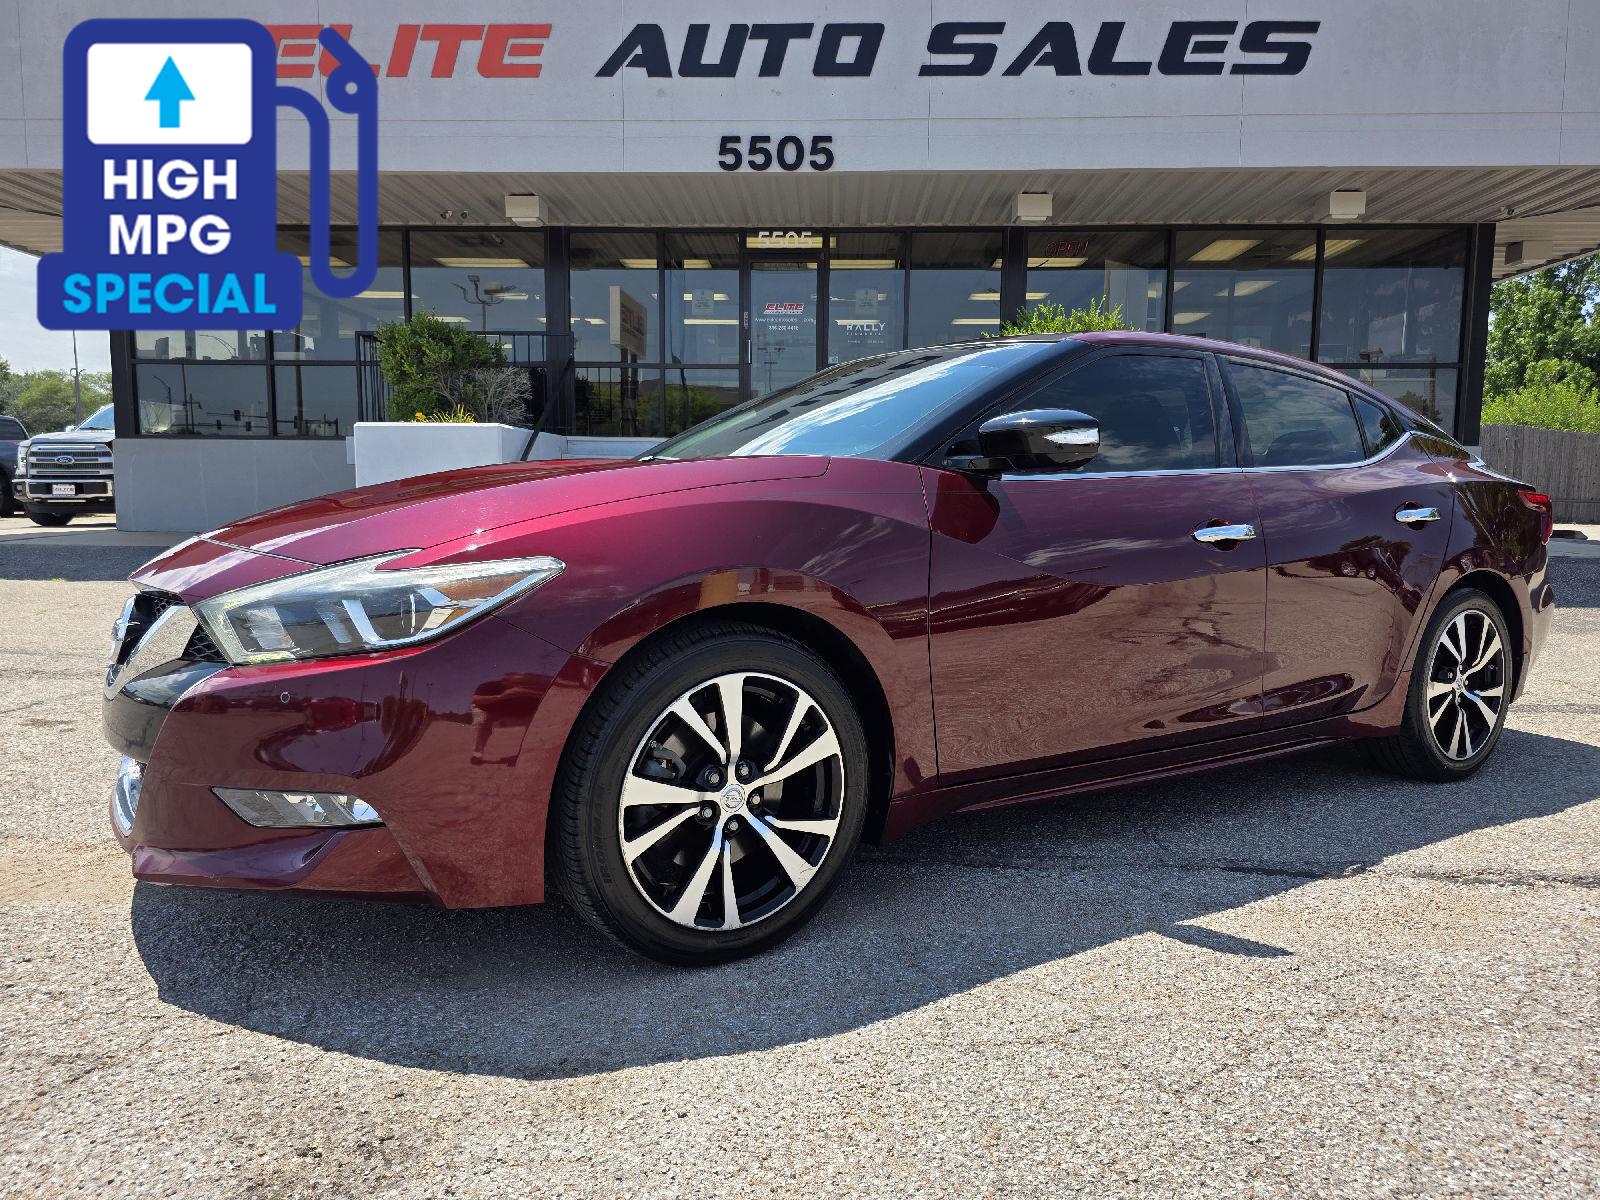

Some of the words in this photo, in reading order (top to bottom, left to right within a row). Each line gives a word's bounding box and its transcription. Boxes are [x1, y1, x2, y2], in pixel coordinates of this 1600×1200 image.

[595, 23, 885, 78] AUTO
[918, 21, 1321, 76] SALES
[718, 136, 834, 171] 5505
[758, 231, 812, 249] 5505
[1045, 240, 1089, 257] OPEN
[765, 303, 804, 311] ELITE
[846, 322, 886, 331] RALLY
